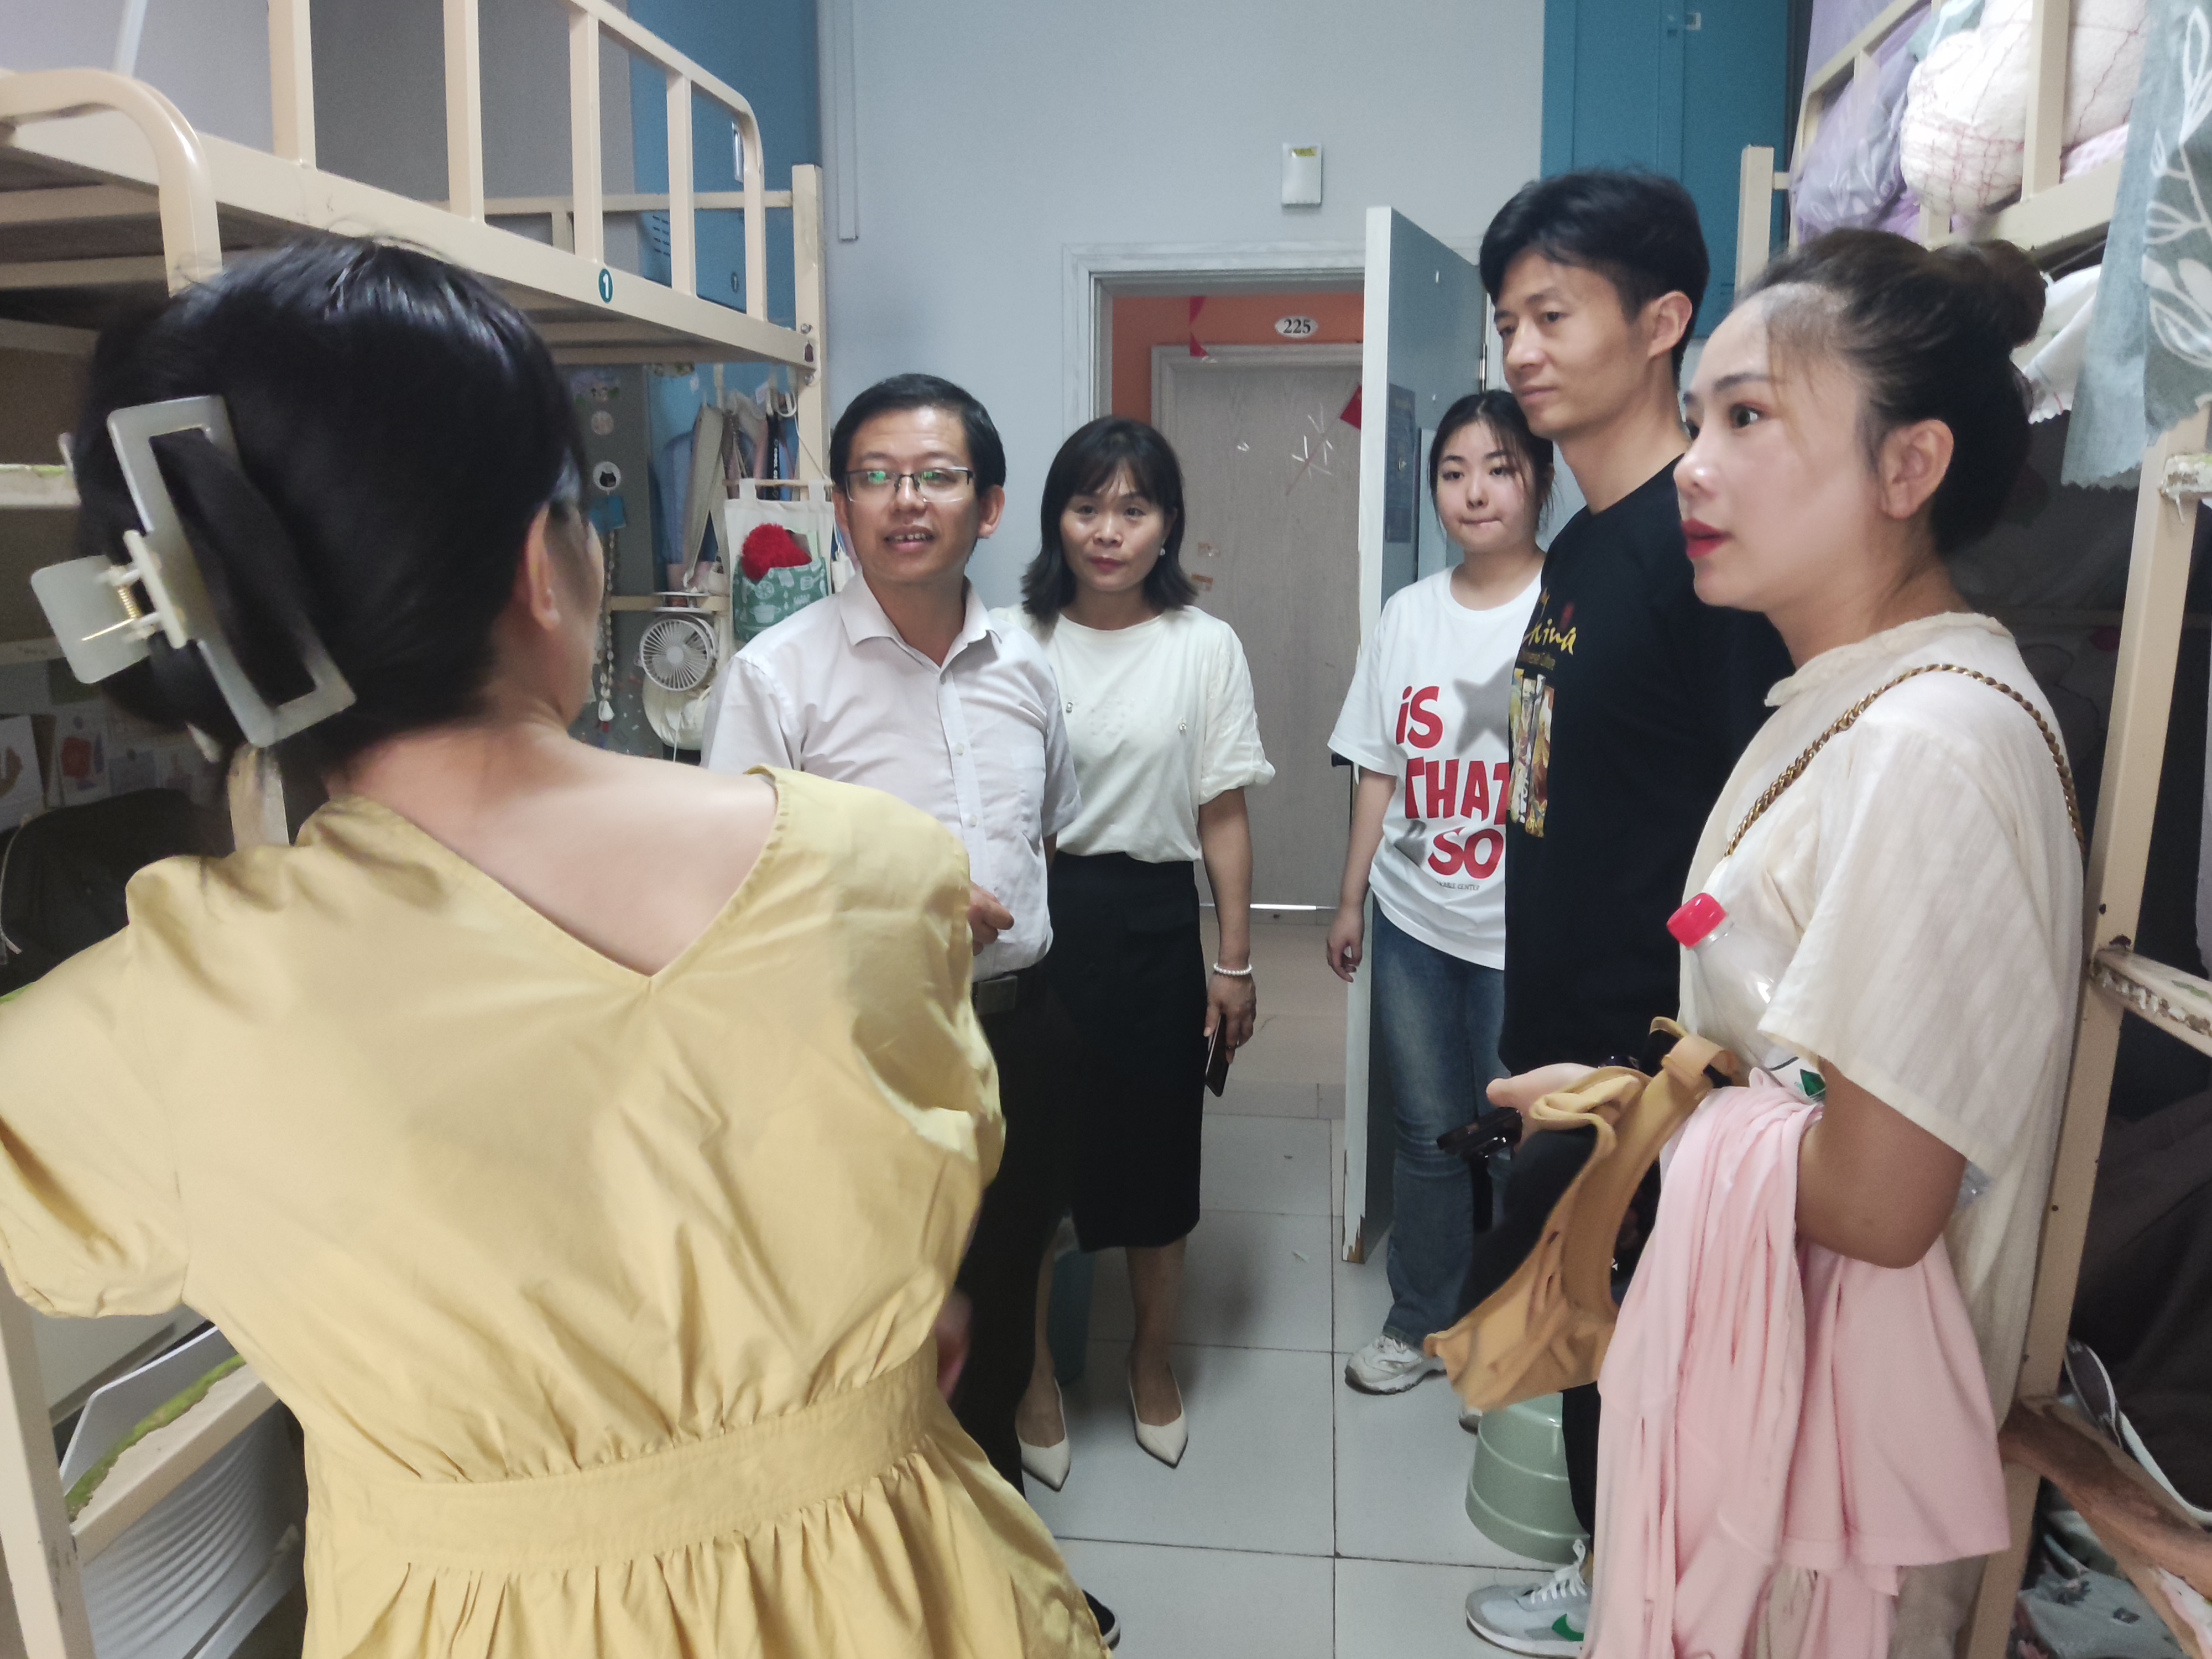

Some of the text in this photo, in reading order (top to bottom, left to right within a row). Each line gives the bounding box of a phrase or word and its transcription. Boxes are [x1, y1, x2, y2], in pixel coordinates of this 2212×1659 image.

[602, 273, 609, 299] 1
[1283, 319, 1311, 334] 225
[1405, 756, 1509, 825] THAT
[1427, 826, 1504, 879] SO
